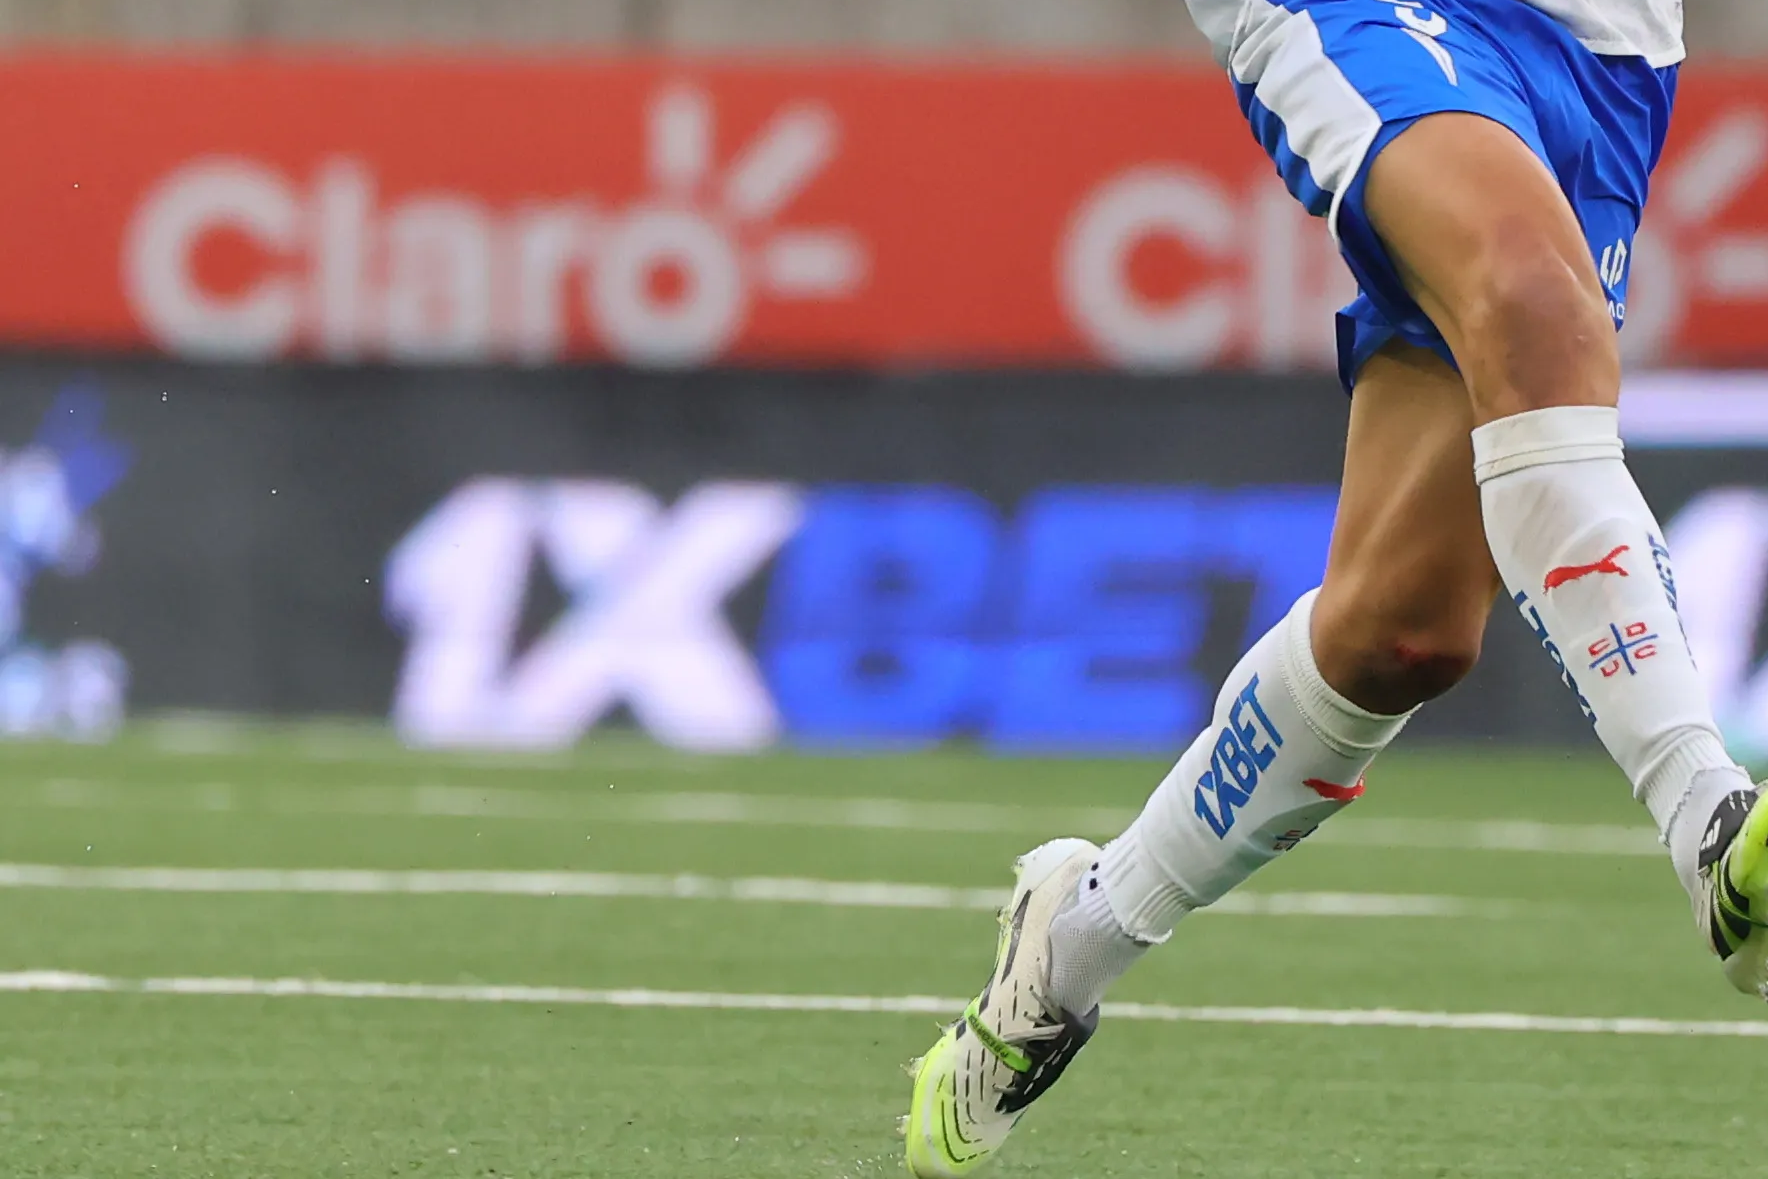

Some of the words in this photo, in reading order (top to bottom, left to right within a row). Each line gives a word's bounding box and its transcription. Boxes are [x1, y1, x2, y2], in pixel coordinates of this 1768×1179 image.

[122, 157, 748, 369] Claro
[383, 475, 1345, 759] 1XBET
[1195, 672, 1283, 840] 1XBET
